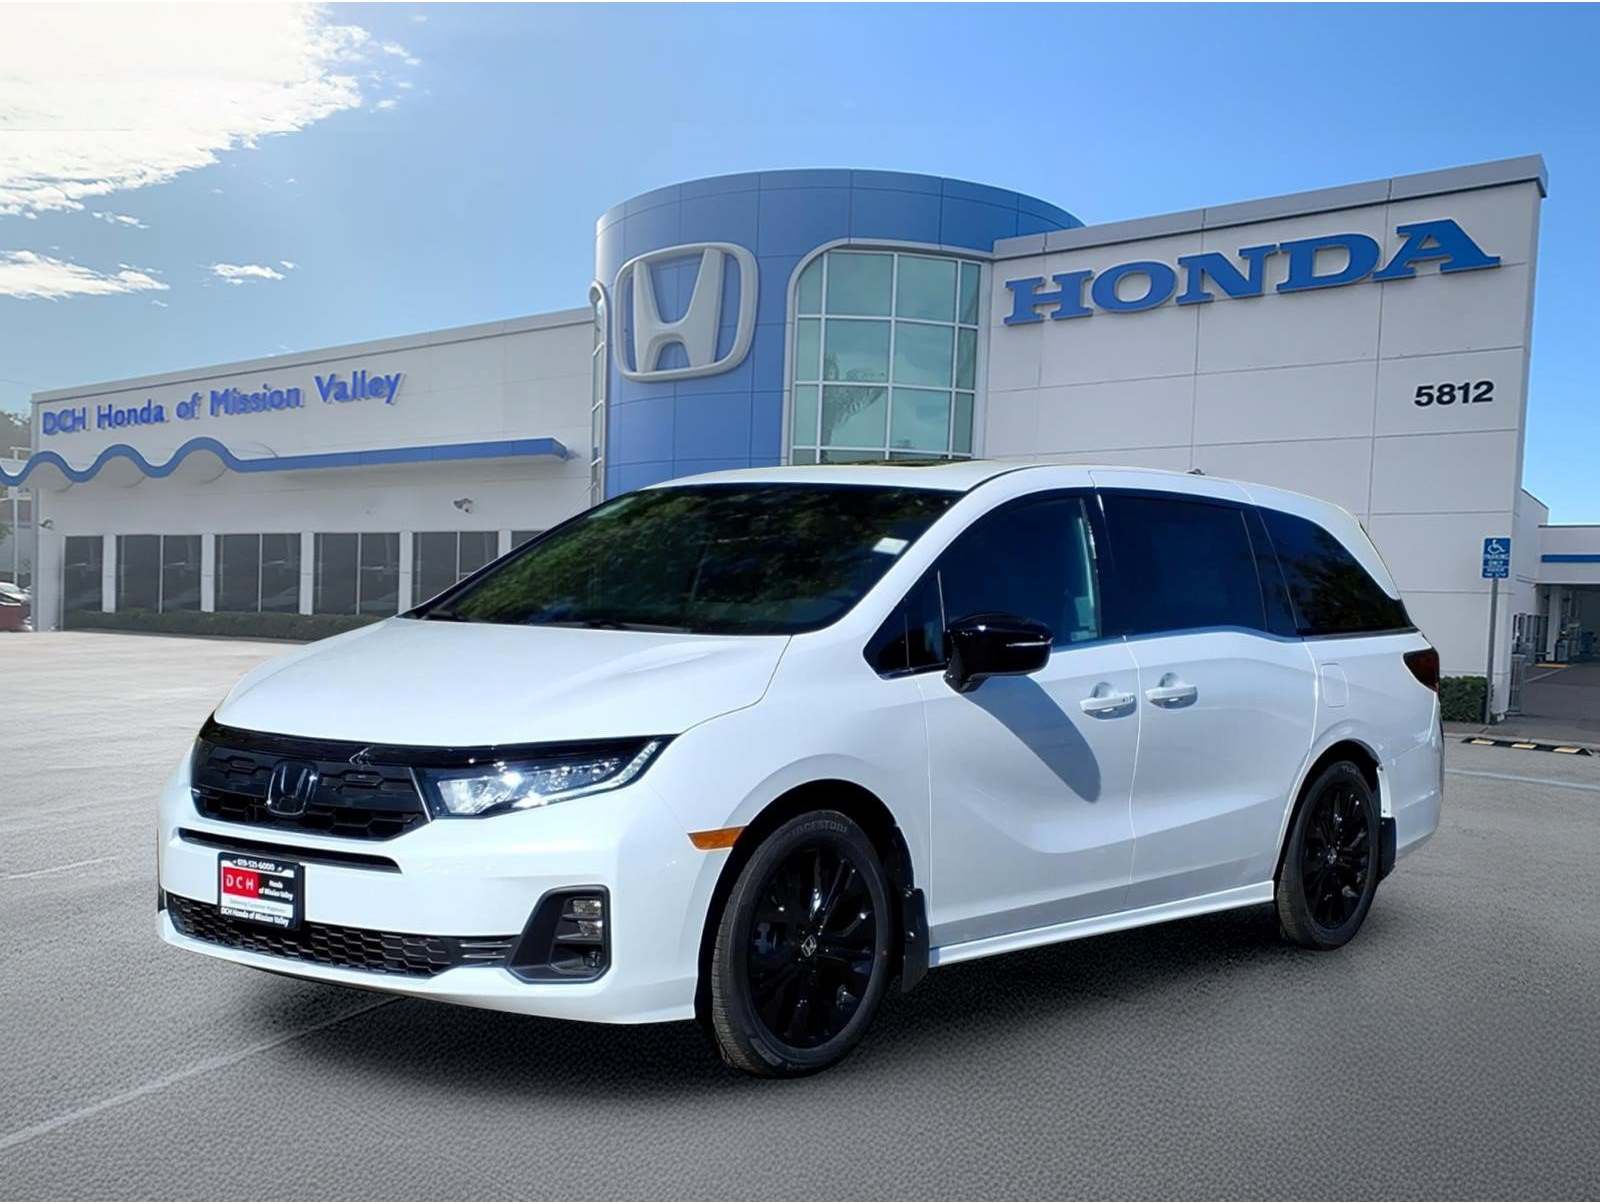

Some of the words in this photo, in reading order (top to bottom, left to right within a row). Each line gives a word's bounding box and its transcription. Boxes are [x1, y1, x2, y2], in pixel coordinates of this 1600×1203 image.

[1003, 218, 1502, 325] HONDA
[42, 407, 87, 436] DCH
[97, 398, 166, 431] Honda
[176, 391, 201, 420] of
[210, 383, 302, 417] Mission
[314, 369, 403, 405] Valley
[1413, 380, 1494, 407] 5812
[226, 874, 255, 892] DCH
[221, 906, 232, 915] DCH
[233, 909, 249, 919] Honda
[274, 916, 289, 928] Valley
